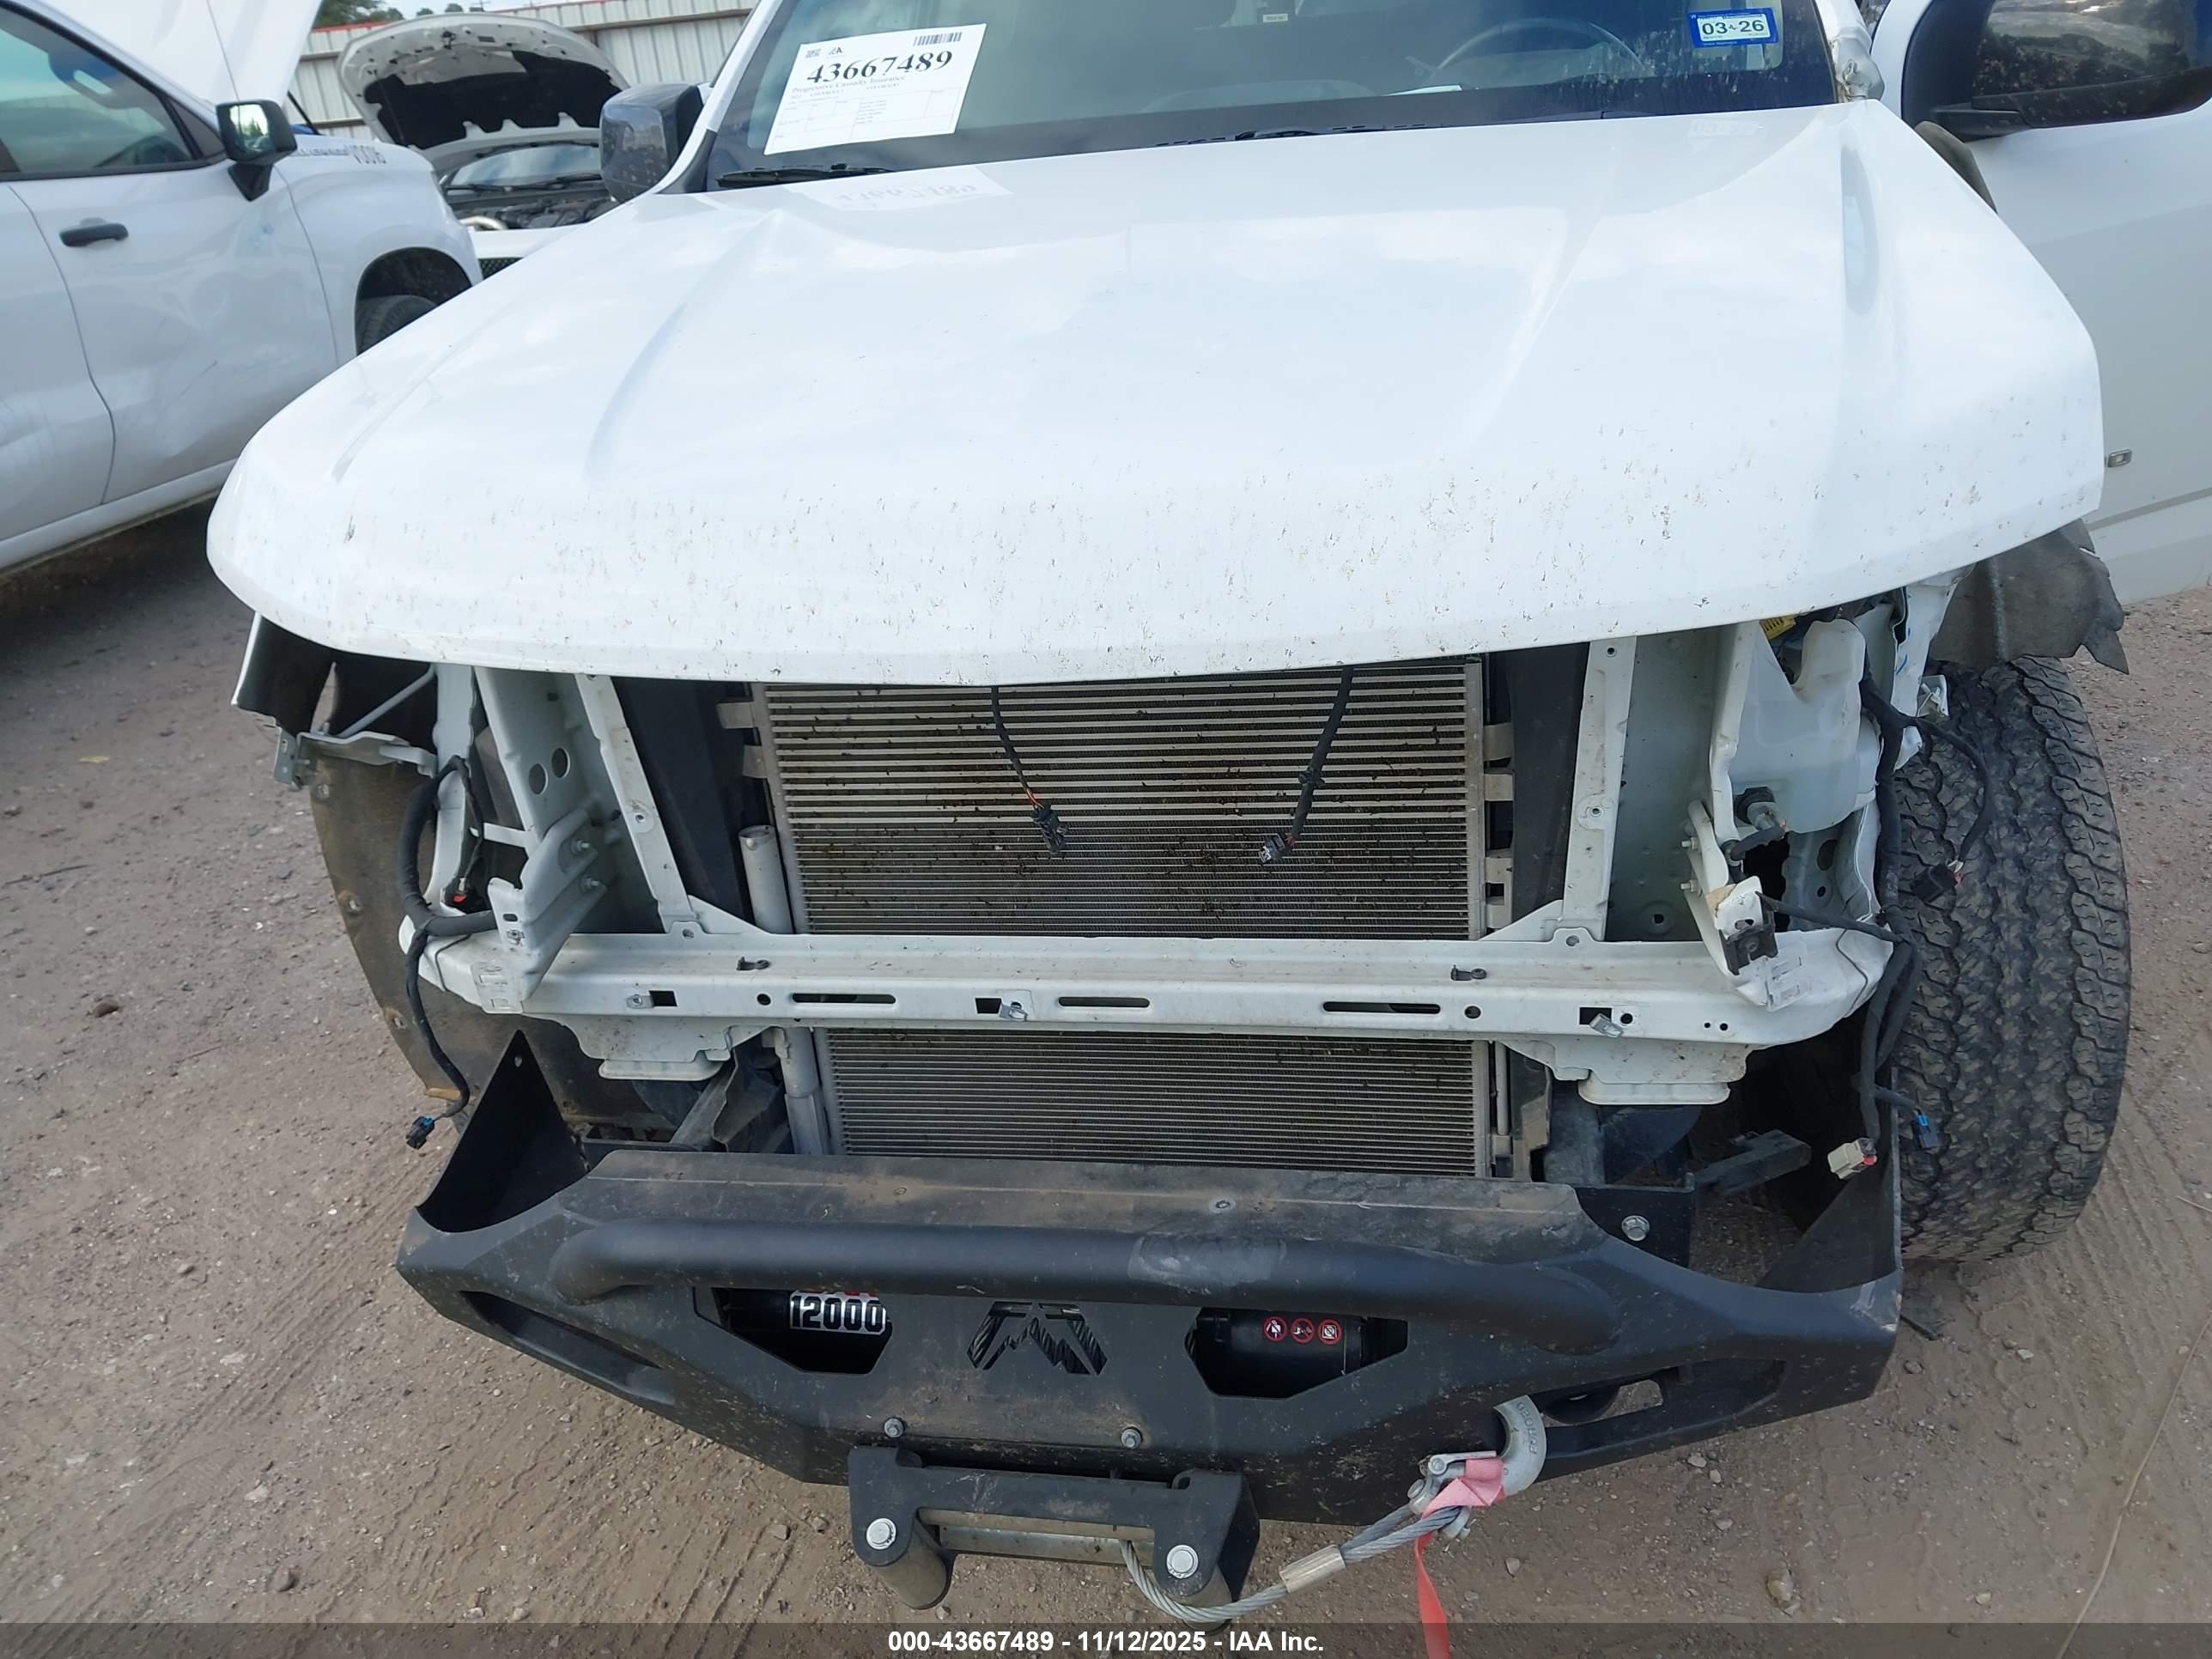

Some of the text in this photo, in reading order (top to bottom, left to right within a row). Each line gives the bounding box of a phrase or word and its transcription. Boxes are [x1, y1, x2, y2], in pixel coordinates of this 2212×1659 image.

[1702, 20, 1765, 35] 03 26
[806, 50, 953, 84] 43667489
[791, 1292, 885, 1334] 12000
